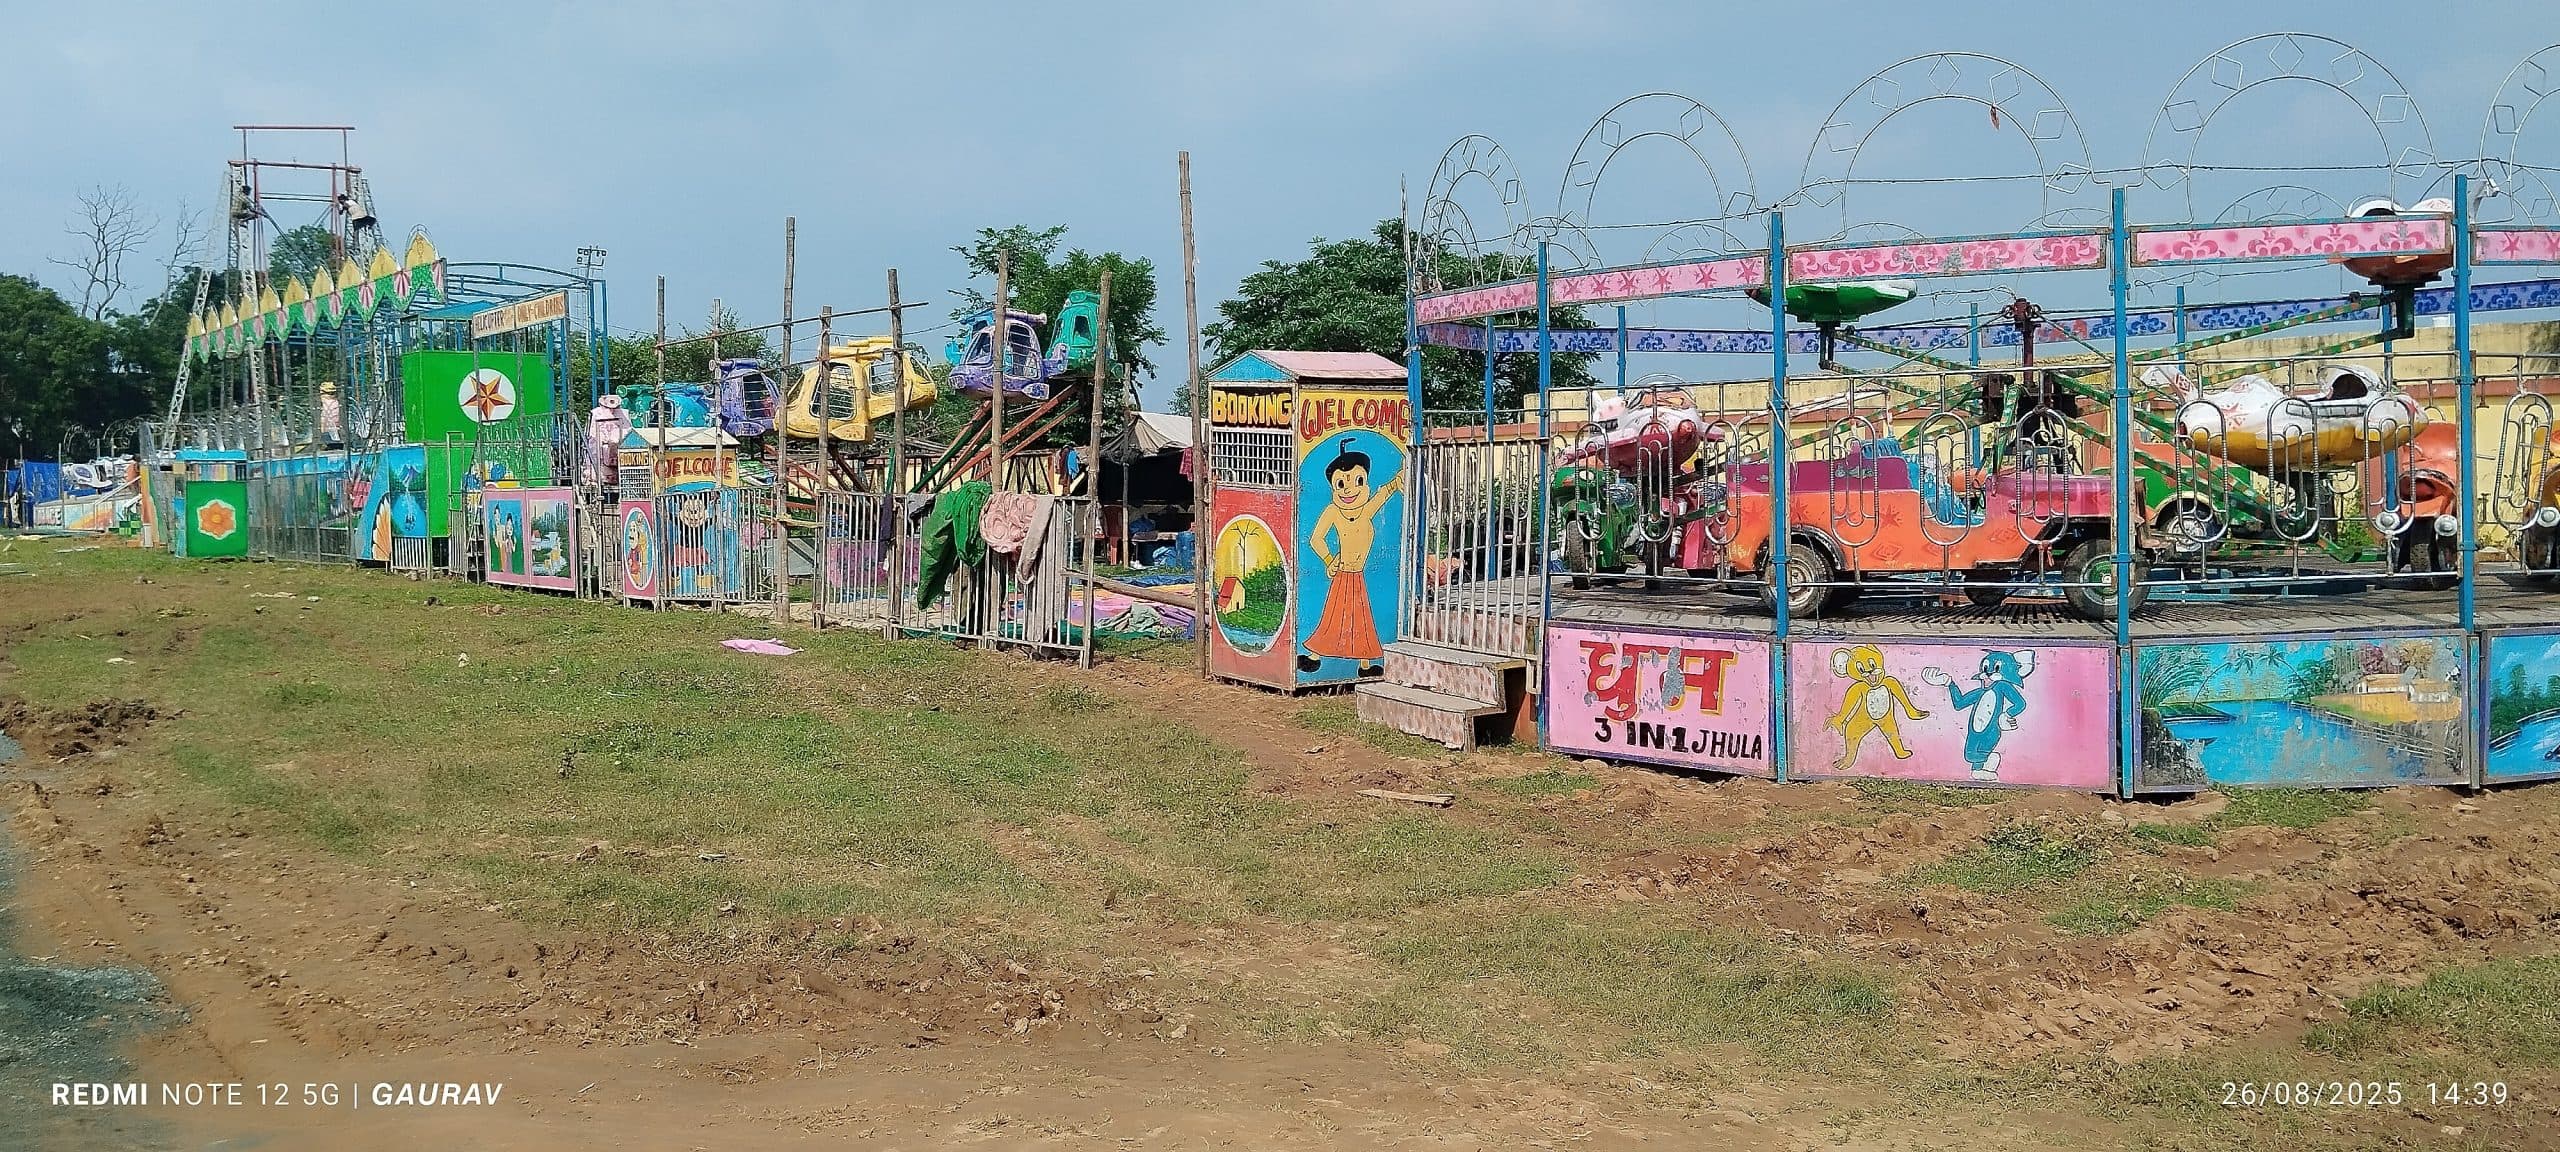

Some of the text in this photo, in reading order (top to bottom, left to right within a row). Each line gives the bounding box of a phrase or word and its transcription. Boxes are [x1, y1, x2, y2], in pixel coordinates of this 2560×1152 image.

[1211, 390, 1293, 427] BOOKING
[1300, 398, 1410, 444] WELCOME
[619, 452, 650, 467] BOOKING
[1594, 717, 1612, 743] 3
[1691, 729, 1762, 761] JHULA
